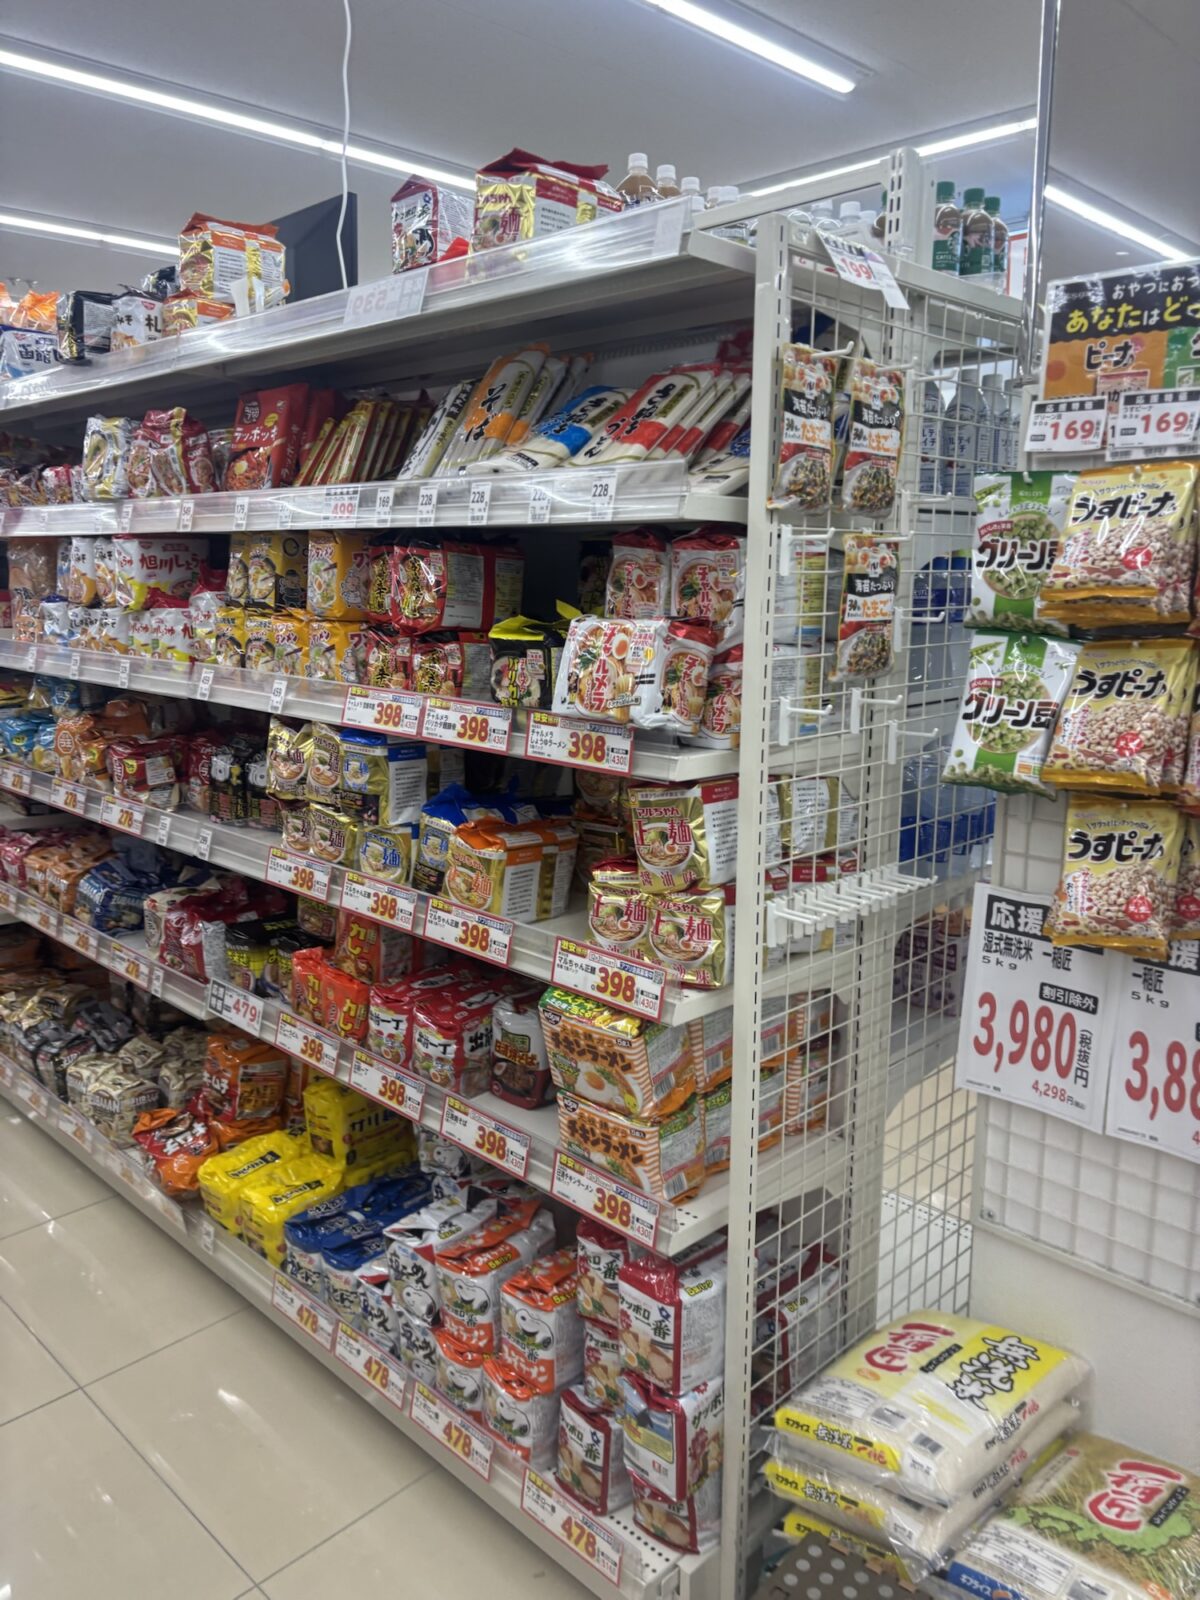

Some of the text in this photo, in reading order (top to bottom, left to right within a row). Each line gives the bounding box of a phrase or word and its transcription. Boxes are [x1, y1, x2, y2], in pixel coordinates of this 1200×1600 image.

[1050, 419, 1094, 441] 169
[1140, 411, 1188, 434] 169
[419, 494, 433, 506] 228
[471, 490, 485, 503] 228
[592, 483, 609, 498] 228
[1071, 491, 1177, 524] うすピーナ
[1073, 669, 1166, 700] うすピーナ
[374, 701, 402, 727] 398
[962, 691, 1060, 729] グリーン豆
[456, 714, 489, 742] 398
[530, 737, 566, 749] しょうゆラーメン
[531, 728, 554, 738] チャルメラ
[568, 731, 606, 763] 398
[636, 807, 680, 817] マルちゃん
[1067, 829, 1165, 864] うすピーナ
[291, 865, 315, 891] 398
[370, 891, 397, 920] 398
[458, 920, 490, 952] 398
[558, 955, 596, 975] マルちゃん正麺
[596, 966, 636, 1003] 398
[232, 999, 257, 1023] 479
[640, 997, 654, 1011] 430
[300, 1034, 324, 1064] 398
[973, 991, 1077, 1079] 3,980
[551, 1030, 632, 1072] チキンラーメン
[377, 1074, 406, 1107] 398
[475, 1124, 507, 1161] 398
[567, 1118, 644, 1164] チキンラーメン
[593, 1186, 632, 1228] 398
[296, 1303, 319, 1334] 478
[363, 1355, 390, 1391] 478
[442, 1420, 473, 1458] 478
[561, 1515, 598, 1559] 478
